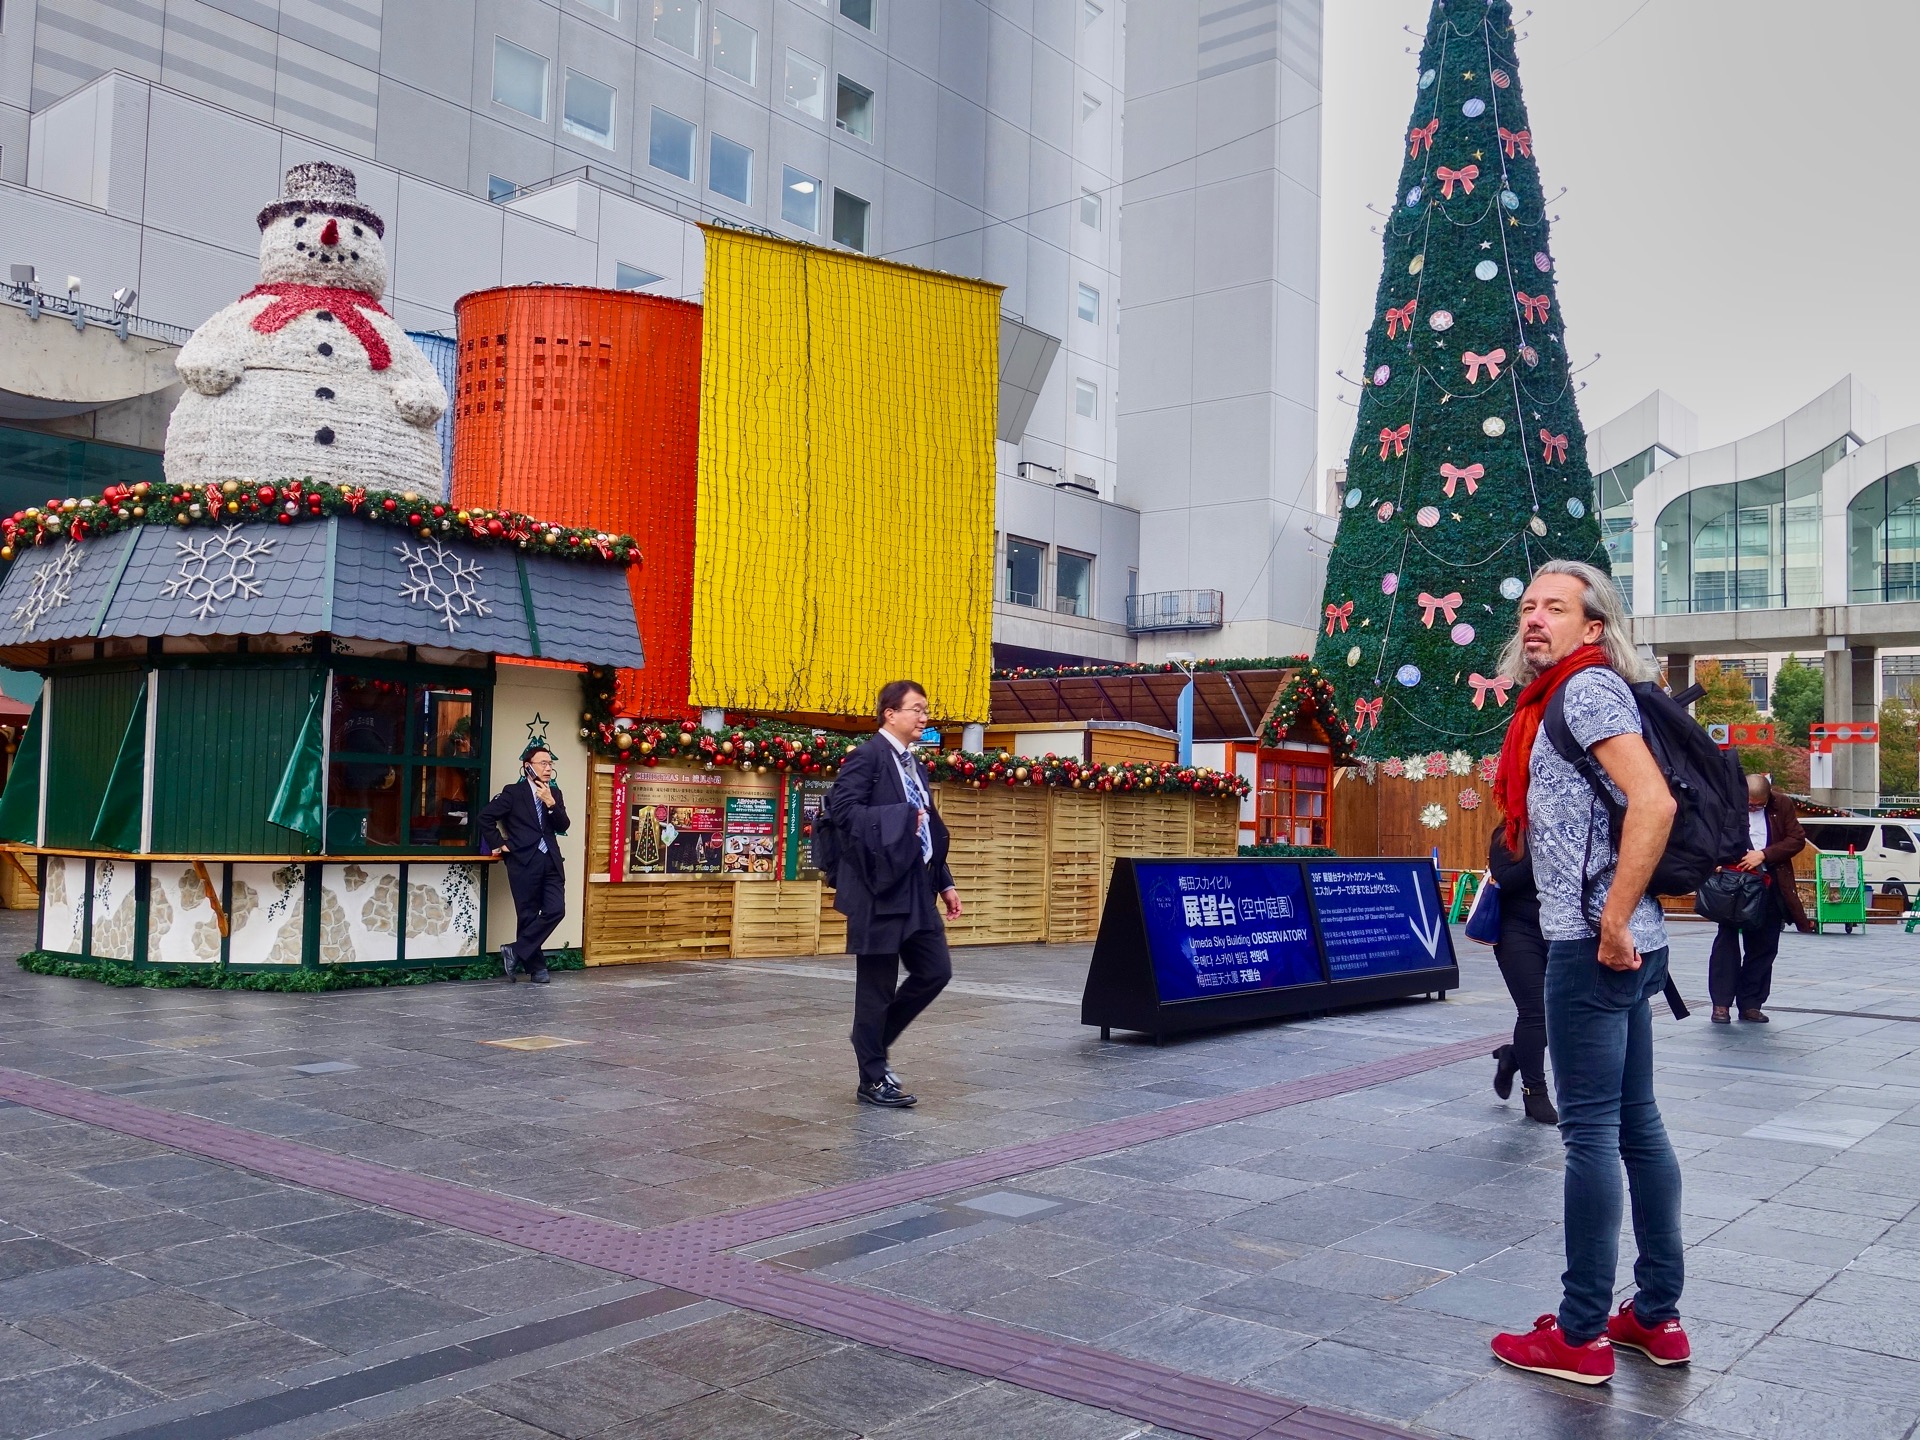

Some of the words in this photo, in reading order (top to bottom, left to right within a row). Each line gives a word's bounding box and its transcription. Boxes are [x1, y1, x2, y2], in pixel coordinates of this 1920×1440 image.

[1178, 875, 1232, 891] 梅田スカイビル
[1189, 936, 1213, 949] Umeda
[1213, 936, 1226, 949] Sky
[1226, 934, 1251, 947] Building
[1251, 929, 1308, 945] OBSERVATORY
